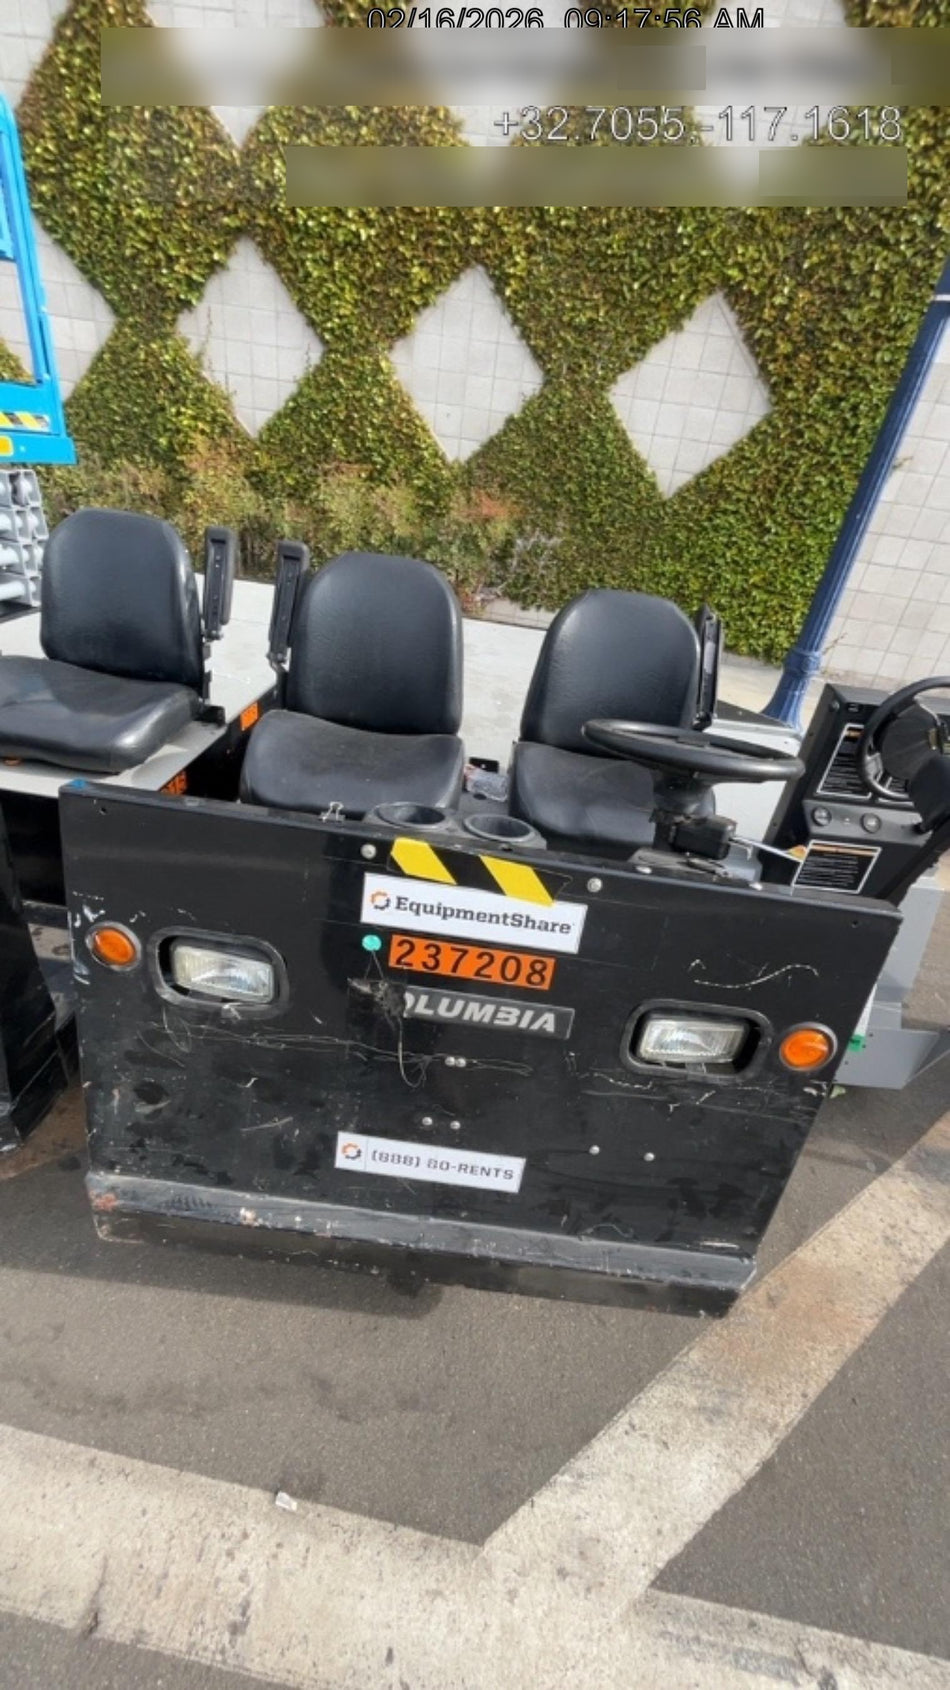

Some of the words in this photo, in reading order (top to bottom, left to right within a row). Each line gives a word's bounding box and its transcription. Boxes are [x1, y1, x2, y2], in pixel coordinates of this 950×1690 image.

[395, 896, 572, 935] EquipmentShare
[395, 939, 548, 986] 237208
[403, 992, 556, 1033] LUMBIA
[371, 1150, 421, 1168] (888)
